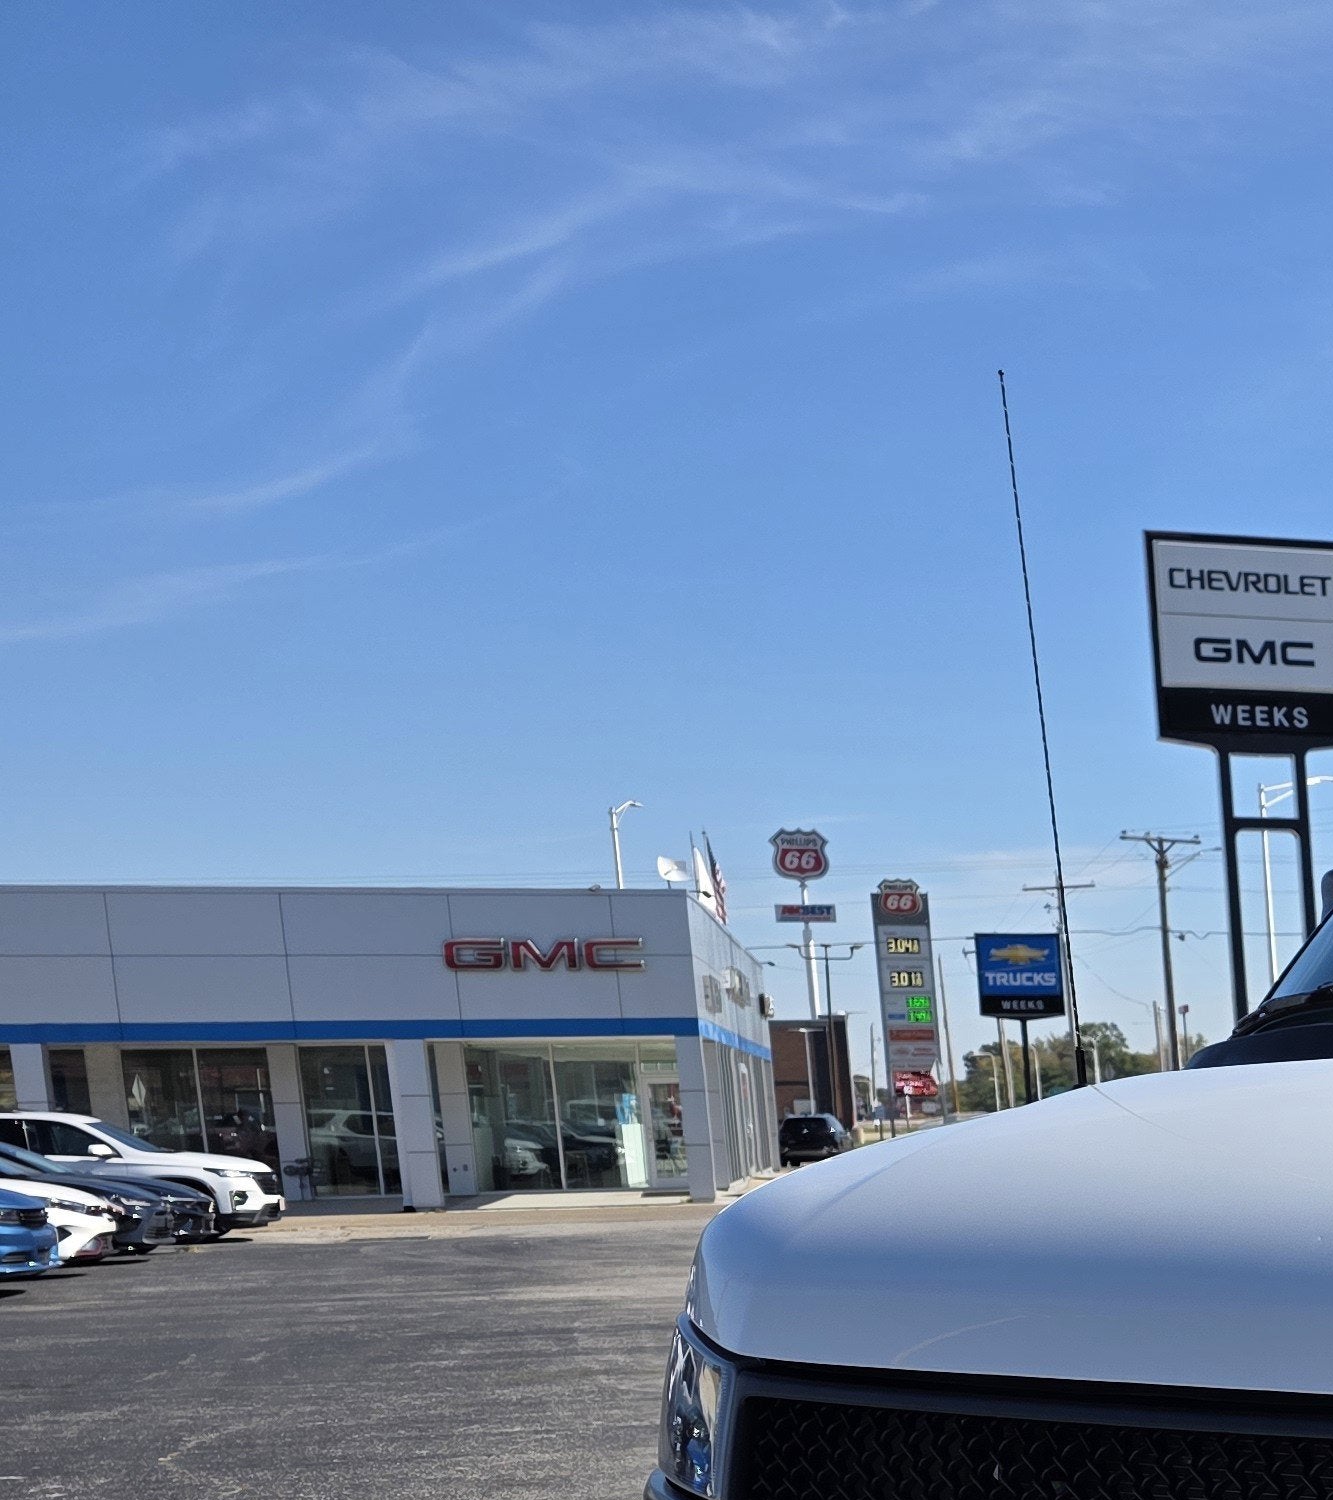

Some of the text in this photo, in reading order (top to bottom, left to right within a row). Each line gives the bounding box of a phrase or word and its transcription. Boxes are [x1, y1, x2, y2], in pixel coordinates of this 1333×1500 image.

[1168, 567, 1332, 597] CHEVROLET
[1194, 637, 1315, 668] GMC
[1211, 704, 1309, 729] WEEKS
[781, 837, 818, 847] PHILLIPS
[784, 851, 817, 869] 66
[886, 894, 913, 910] 66
[443, 937, 645, 971] GMC
[984, 971, 1057, 986] TRUCKS
[1001, 1000, 1045, 1010] WEEKS
